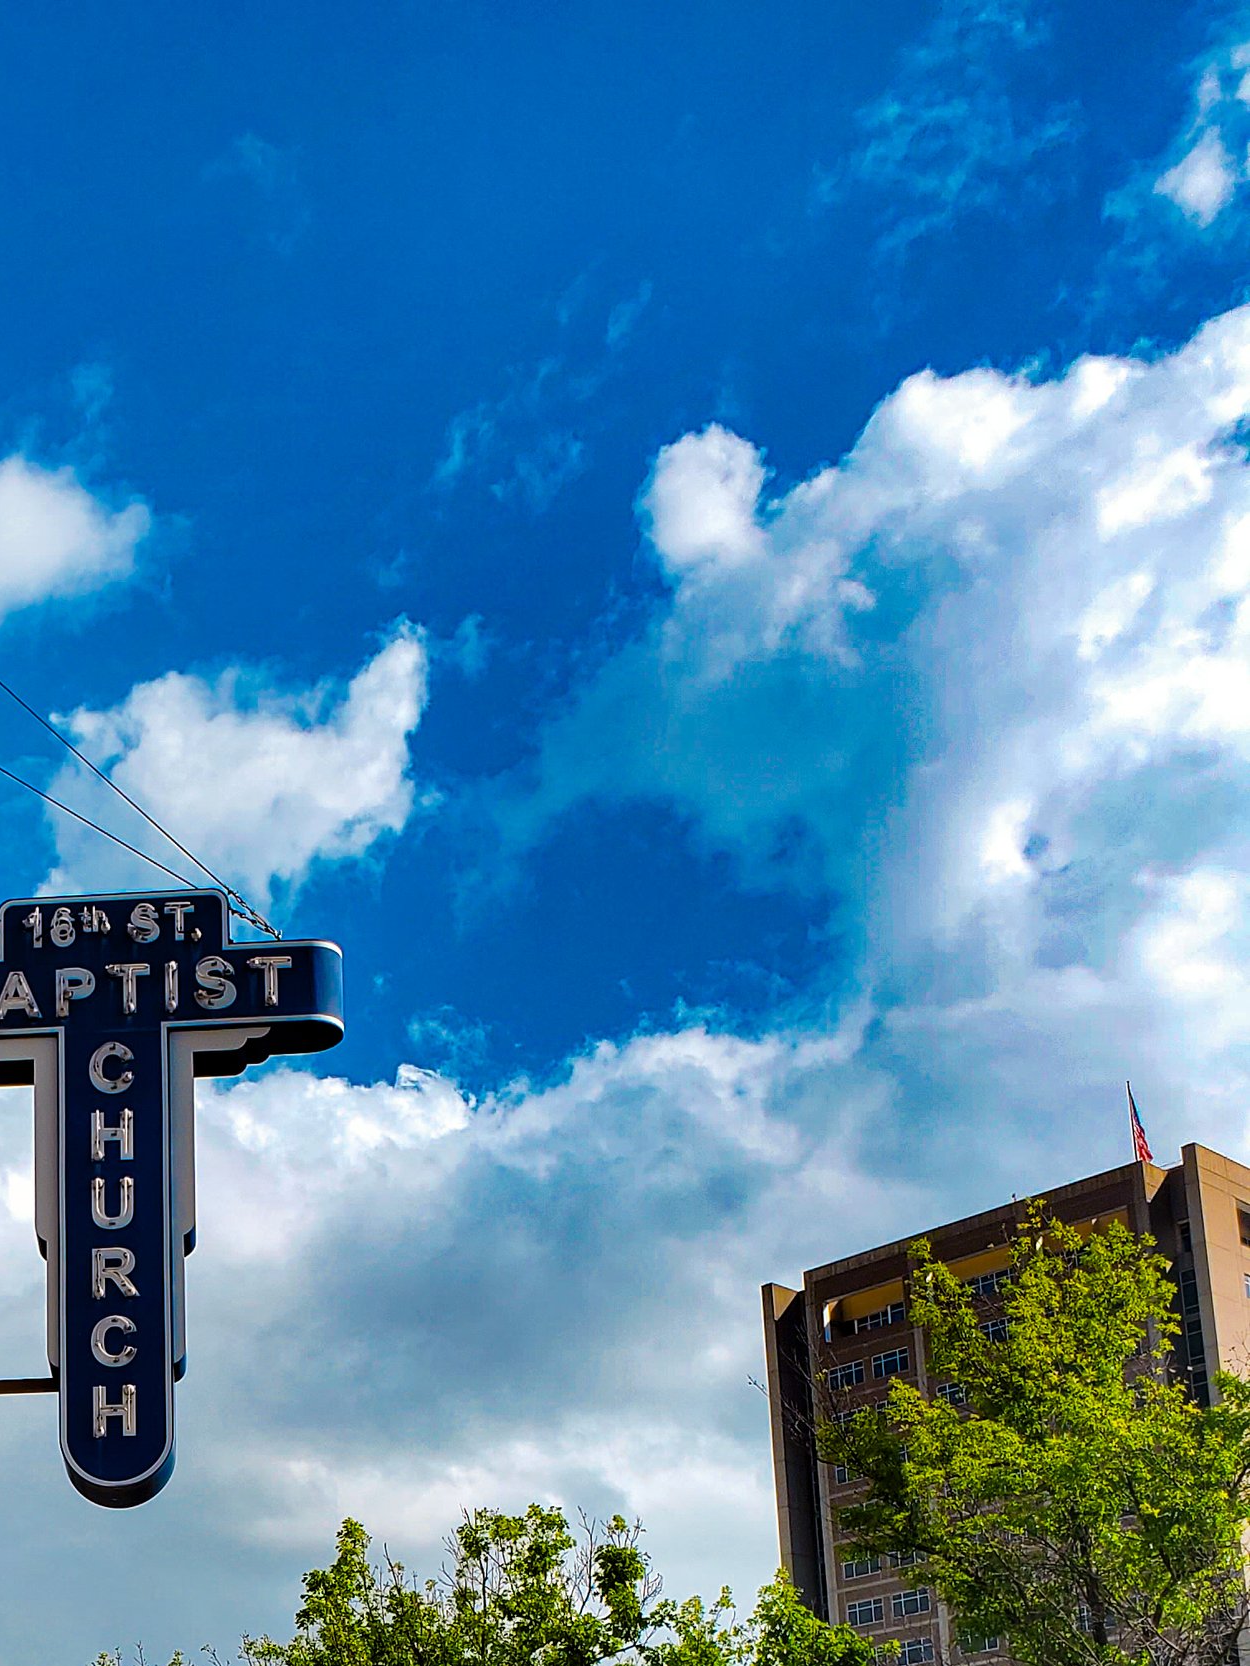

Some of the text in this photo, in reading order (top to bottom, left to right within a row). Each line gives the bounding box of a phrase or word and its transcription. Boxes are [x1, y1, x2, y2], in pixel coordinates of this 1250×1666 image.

[22, 901, 203, 948] 16th ST.
[89, 1041, 141, 1439] CHURCH
